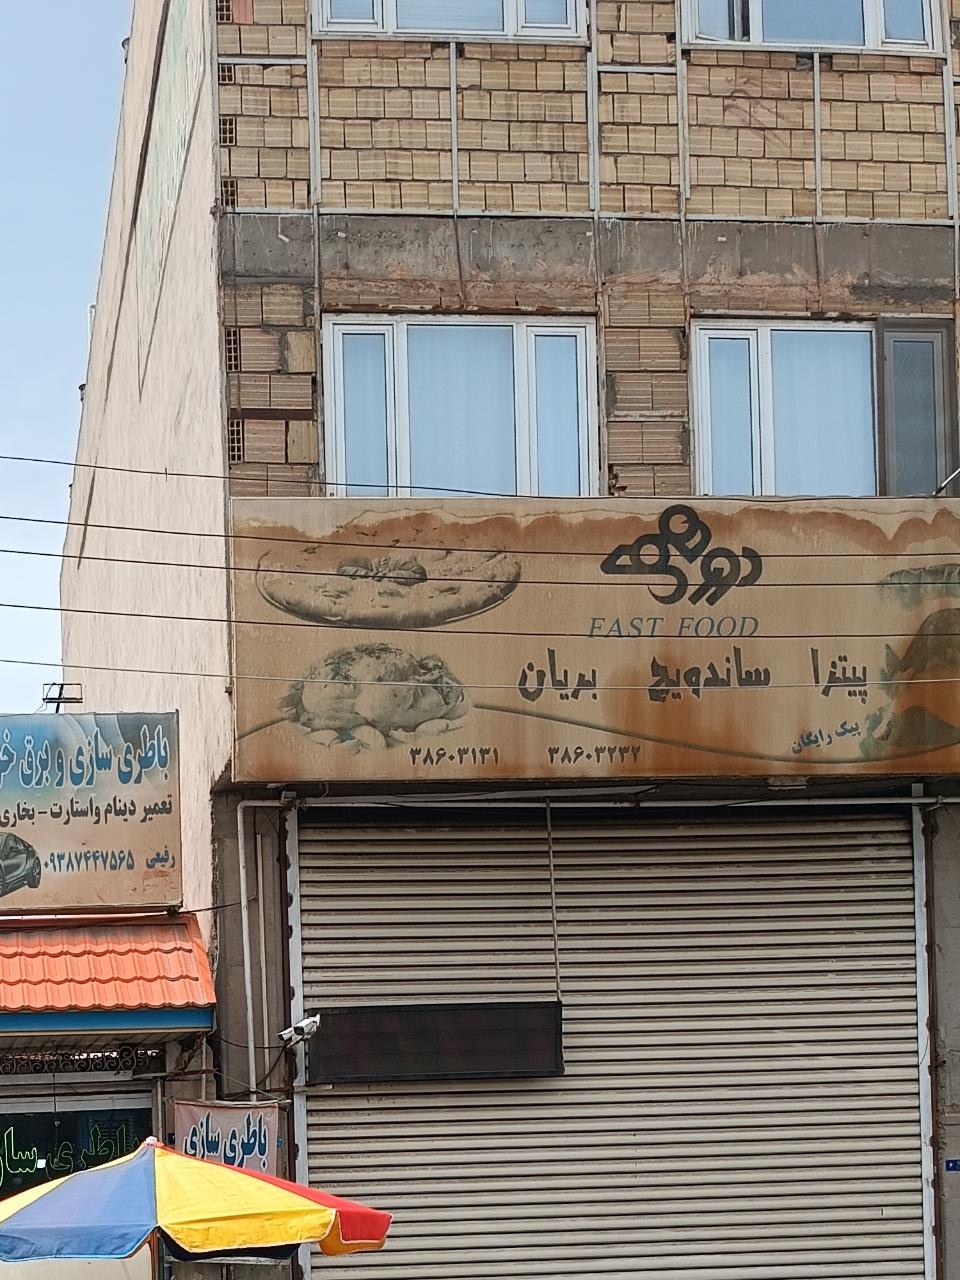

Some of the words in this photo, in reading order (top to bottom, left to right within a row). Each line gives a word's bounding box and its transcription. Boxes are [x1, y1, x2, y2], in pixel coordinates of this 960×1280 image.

[588, 617, 664, 638] FAST
[678, 616, 759, 637] FOOD
[518, 648, 598, 701] بریان
[648, 645, 771, 703] ساندویچ
[810, 647, 868, 704] پیتزا
[792, 728, 832, 754] رایگان
[835, 720, 861, 737] پیک
[19, 735, 50, 787] برق
[55, 749, 64, 787] و
[69, 727, 113, 787] سازی
[117, 724, 170, 785] باطری
[410, 747, 499, 767] ۳۸۶۰۳۱۳۱
[548, 745, 640, 764] ۳۸۶۰۳۲۳۲
[104, 795, 137, 824] دینام
[140, 794, 173, 823] تعمیر
[43, 849, 135, 873] ۰۹۳۸۷۴۴۷۵۶۵
[146, 845, 176, 869] رفیعی
[183, 1110, 221, 1159] سازی
[222, 1111, 268, 1172] باطری
